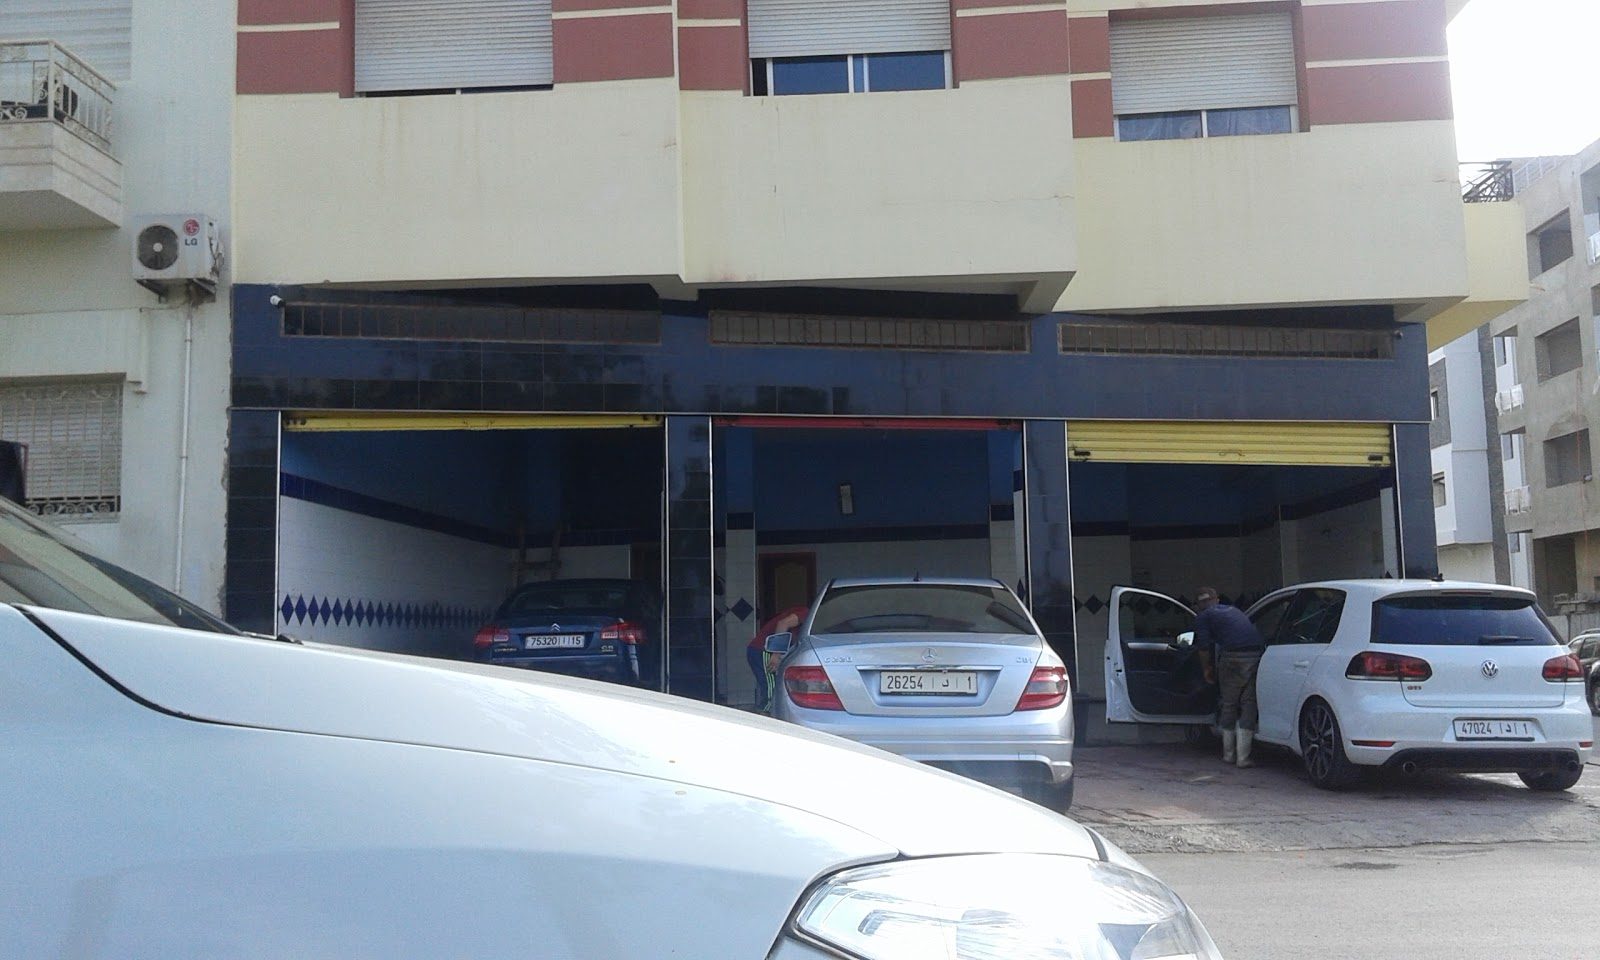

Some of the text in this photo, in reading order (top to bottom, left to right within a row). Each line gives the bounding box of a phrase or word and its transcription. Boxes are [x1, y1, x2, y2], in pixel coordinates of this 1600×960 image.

[184, 237, 198, 246] LG
[531, 637, 557, 646] 75320
[572, 636, 581, 645] 15
[887, 675, 923, 690] 26254
[1462, 722, 1492, 735] 47024
